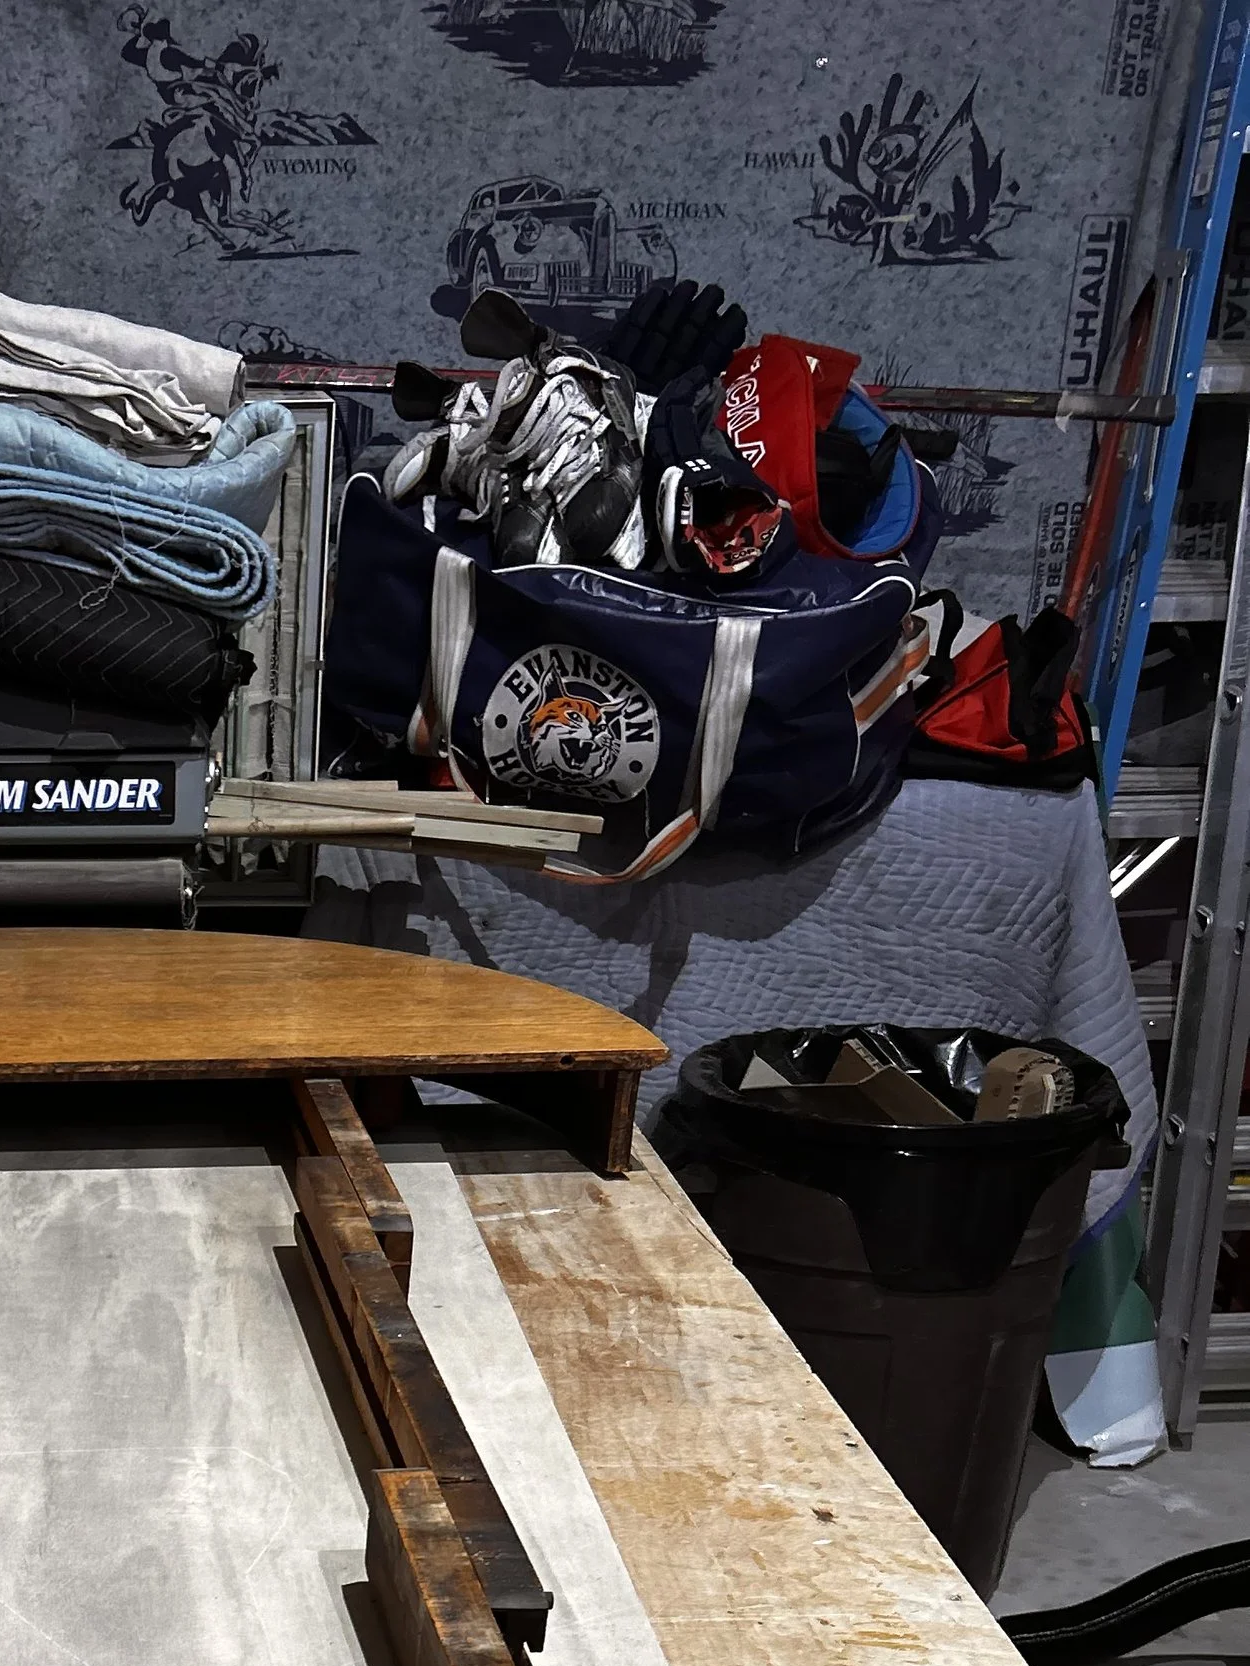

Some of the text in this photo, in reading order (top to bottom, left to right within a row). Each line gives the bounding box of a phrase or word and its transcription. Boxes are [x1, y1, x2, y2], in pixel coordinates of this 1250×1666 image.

[1127, 15, 1142, 43] TO
[1119, 51, 1137, 96] NOT
[1135, 69, 1149, 96] OR
[262, 159, 357, 180] WYOMING
[743, 152, 816, 168] HAWAII
[627, 202, 727, 218] MICHIGAN
[1067, 221, 1113, 385] U-HAUL
[1049, 502, 1068, 554] SOLD
[1046, 563, 1062, 587] BE
[504, 650, 654, 743] EVANSTON
[32, 778, 163, 812] SANDER
